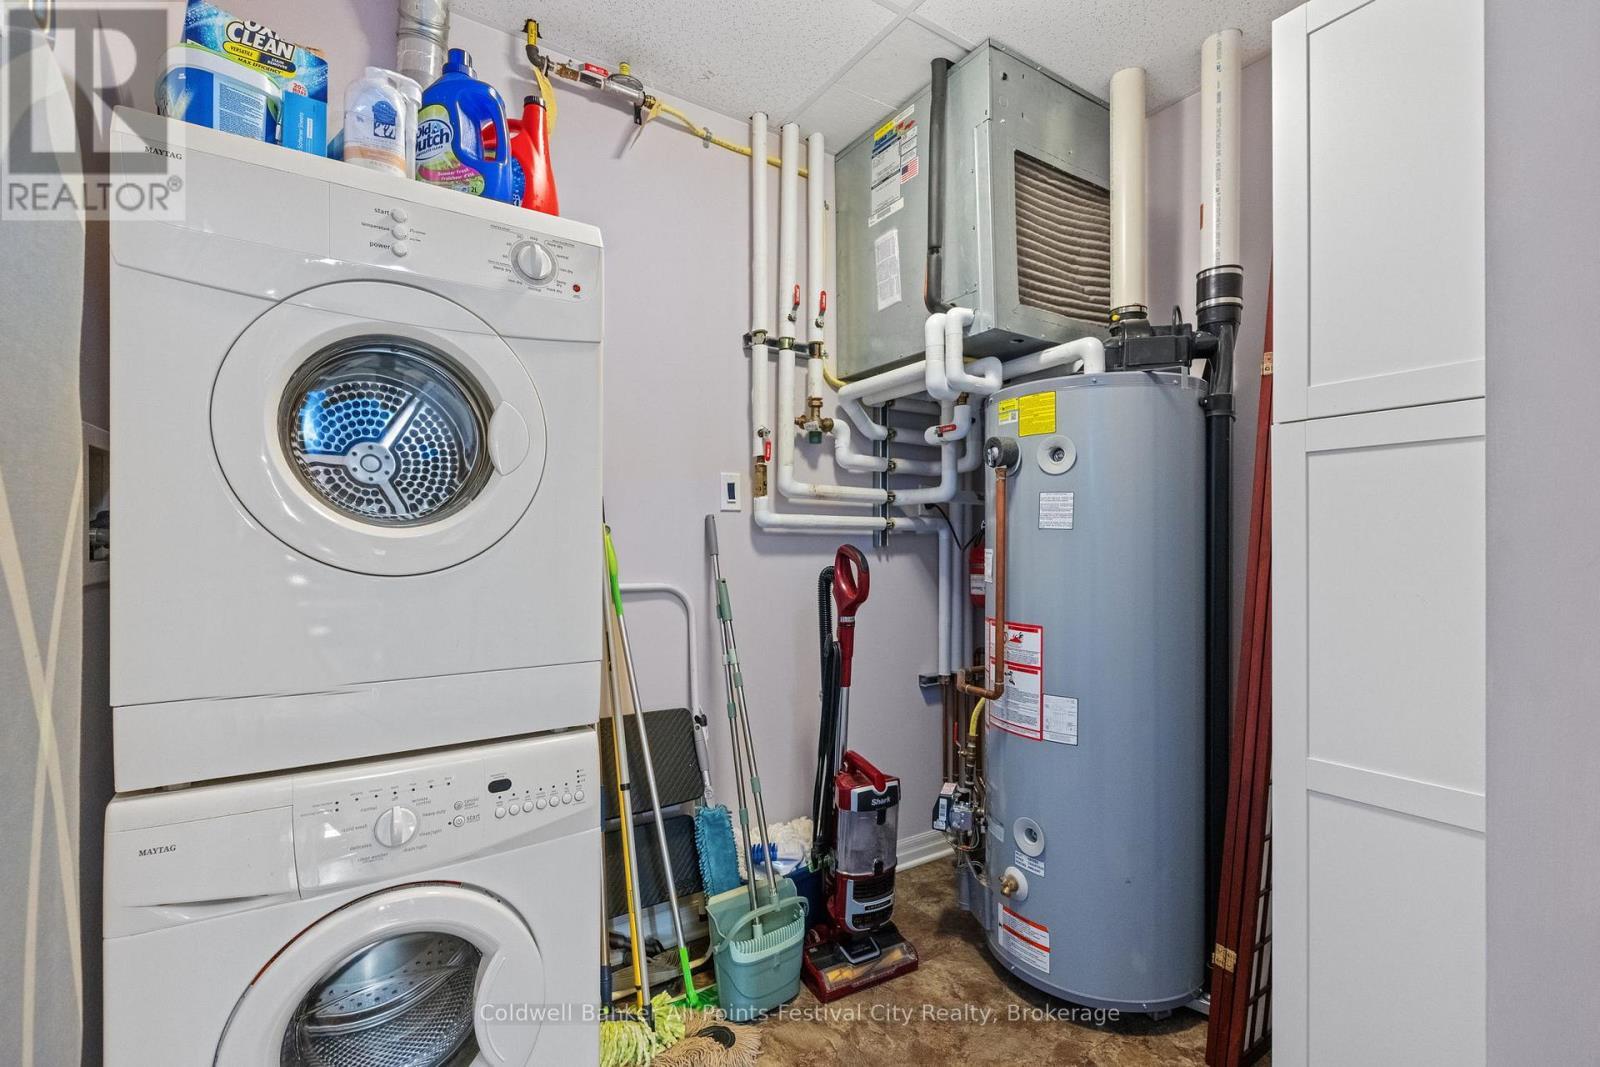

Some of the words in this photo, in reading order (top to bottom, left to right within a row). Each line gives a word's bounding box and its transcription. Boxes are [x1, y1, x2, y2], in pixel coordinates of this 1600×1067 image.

[226, 20, 294, 60] CLEAN
[237, 57, 252, 66] MAX
[252, 62, 282, 75] EFFICIENCY
[144, 145, 182, 160] MAYTAG
[374, 207, 390, 216] start
[369, 241, 391, 250] power
[871, 797, 891, 806] Shark
[138, 844, 177, 857] MAYTAG
